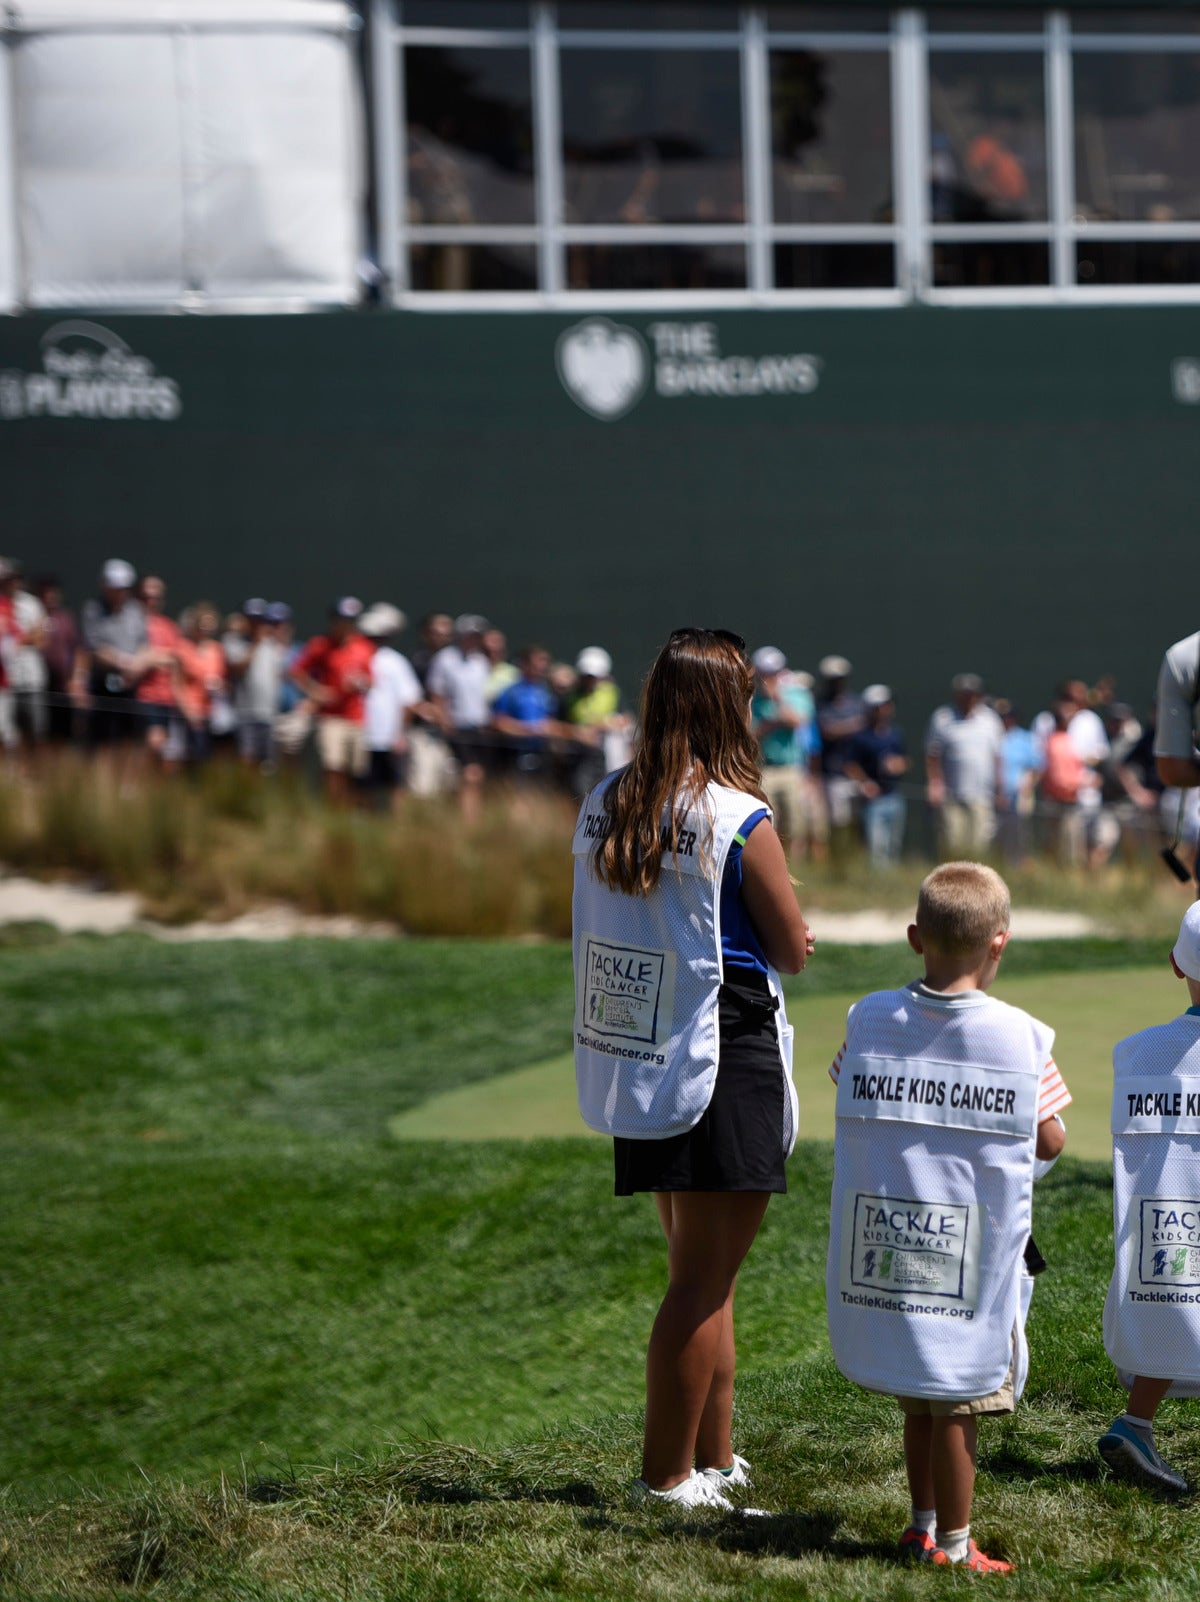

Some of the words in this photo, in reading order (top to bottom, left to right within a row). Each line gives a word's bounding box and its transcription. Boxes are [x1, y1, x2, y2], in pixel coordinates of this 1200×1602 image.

[591, 951, 654, 984] TACKLE
[605, 977, 648, 996] CANCER
[577, 1033, 665, 1064] TackleKidsCancer.org
[852, 1075, 905, 1101] TACKLE
[908, 1078, 946, 1107] KIDS
[950, 1082, 1016, 1115] CANCER
[1128, 1093, 1182, 1117] TACKLE
[865, 1204, 959, 1237] TACKLE
[863, 1230, 890, 1242] KIDS
[895, 1233, 952, 1249] CANCER
[1152, 1231, 1183, 1242] KIDS
[841, 1291, 975, 1320] TackleKidsCancer.org
